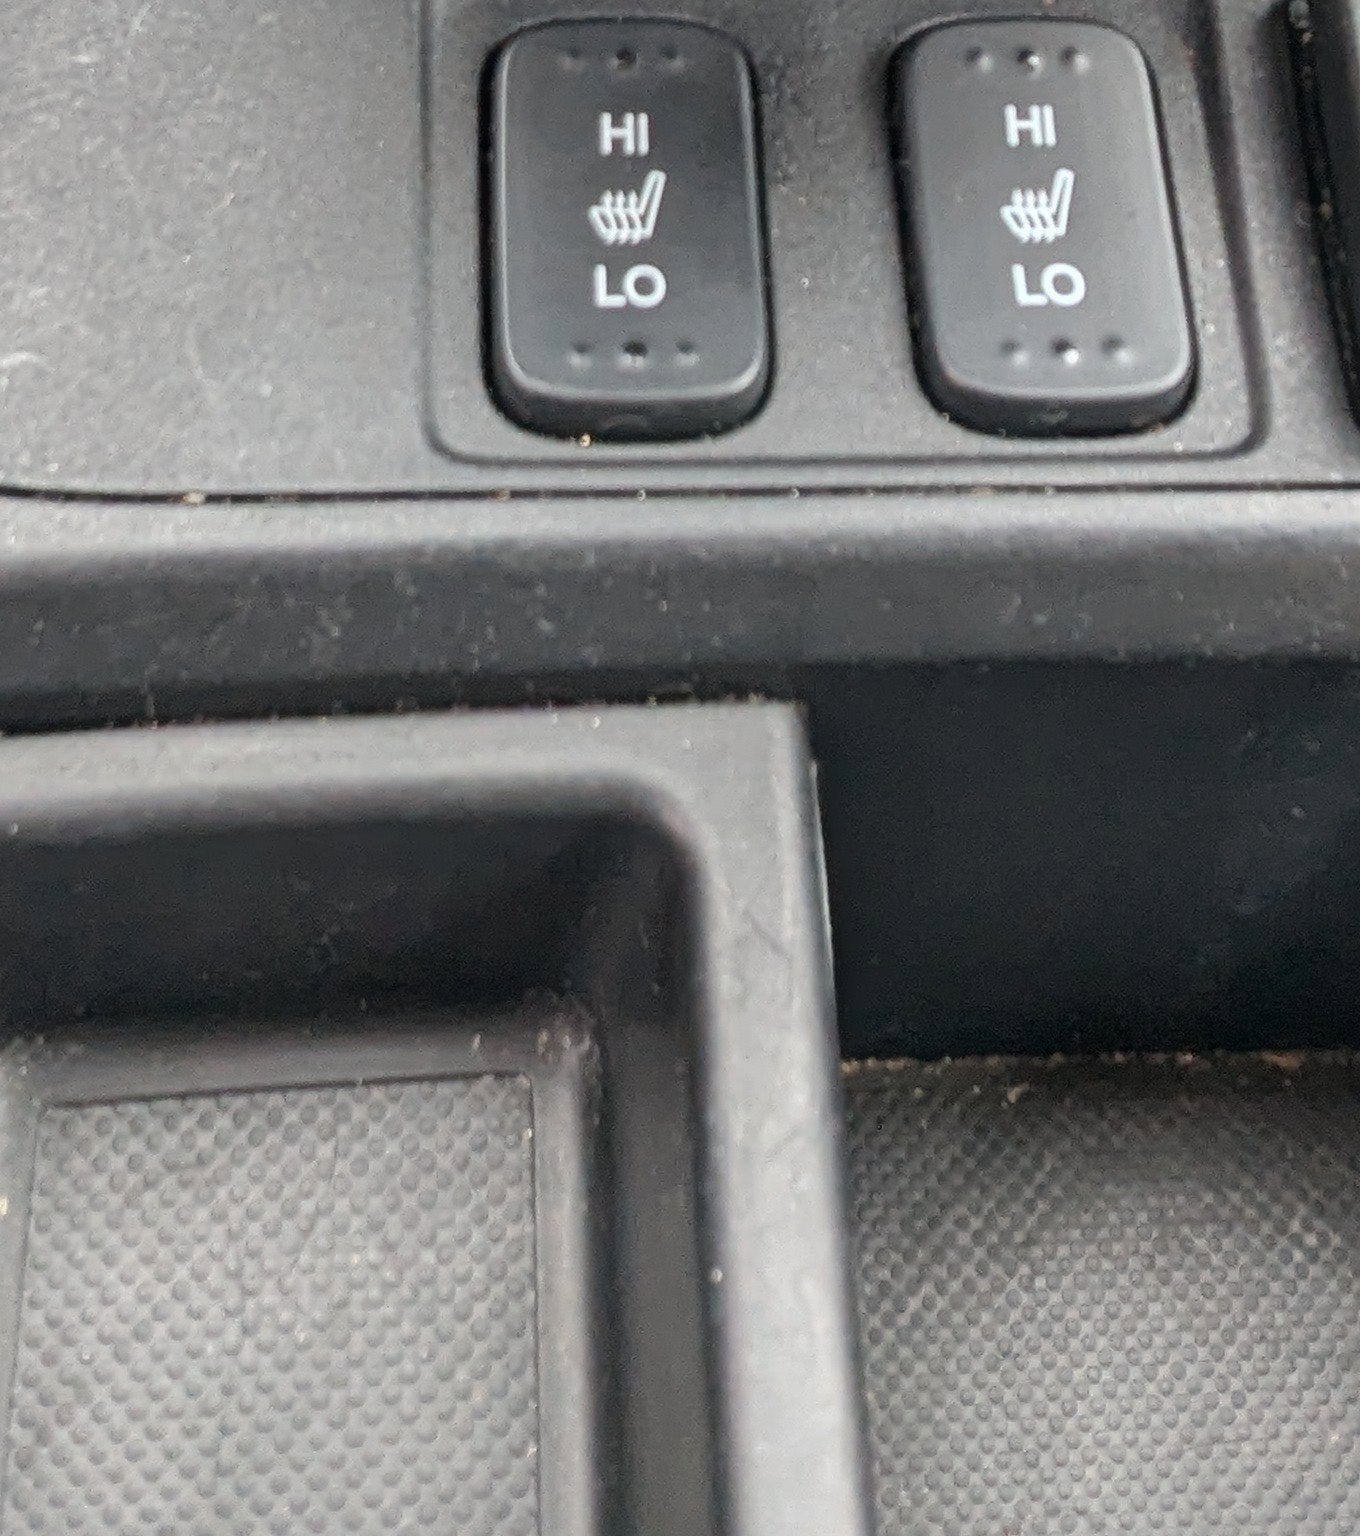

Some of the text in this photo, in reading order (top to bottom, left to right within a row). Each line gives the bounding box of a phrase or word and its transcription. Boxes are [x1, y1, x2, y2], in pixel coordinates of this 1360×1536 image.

[599, 112, 649, 156] HI
[1005, 104, 1056, 147] HI
[593, 264, 667, 307] LO
[1011, 262, 1086, 307] LO
